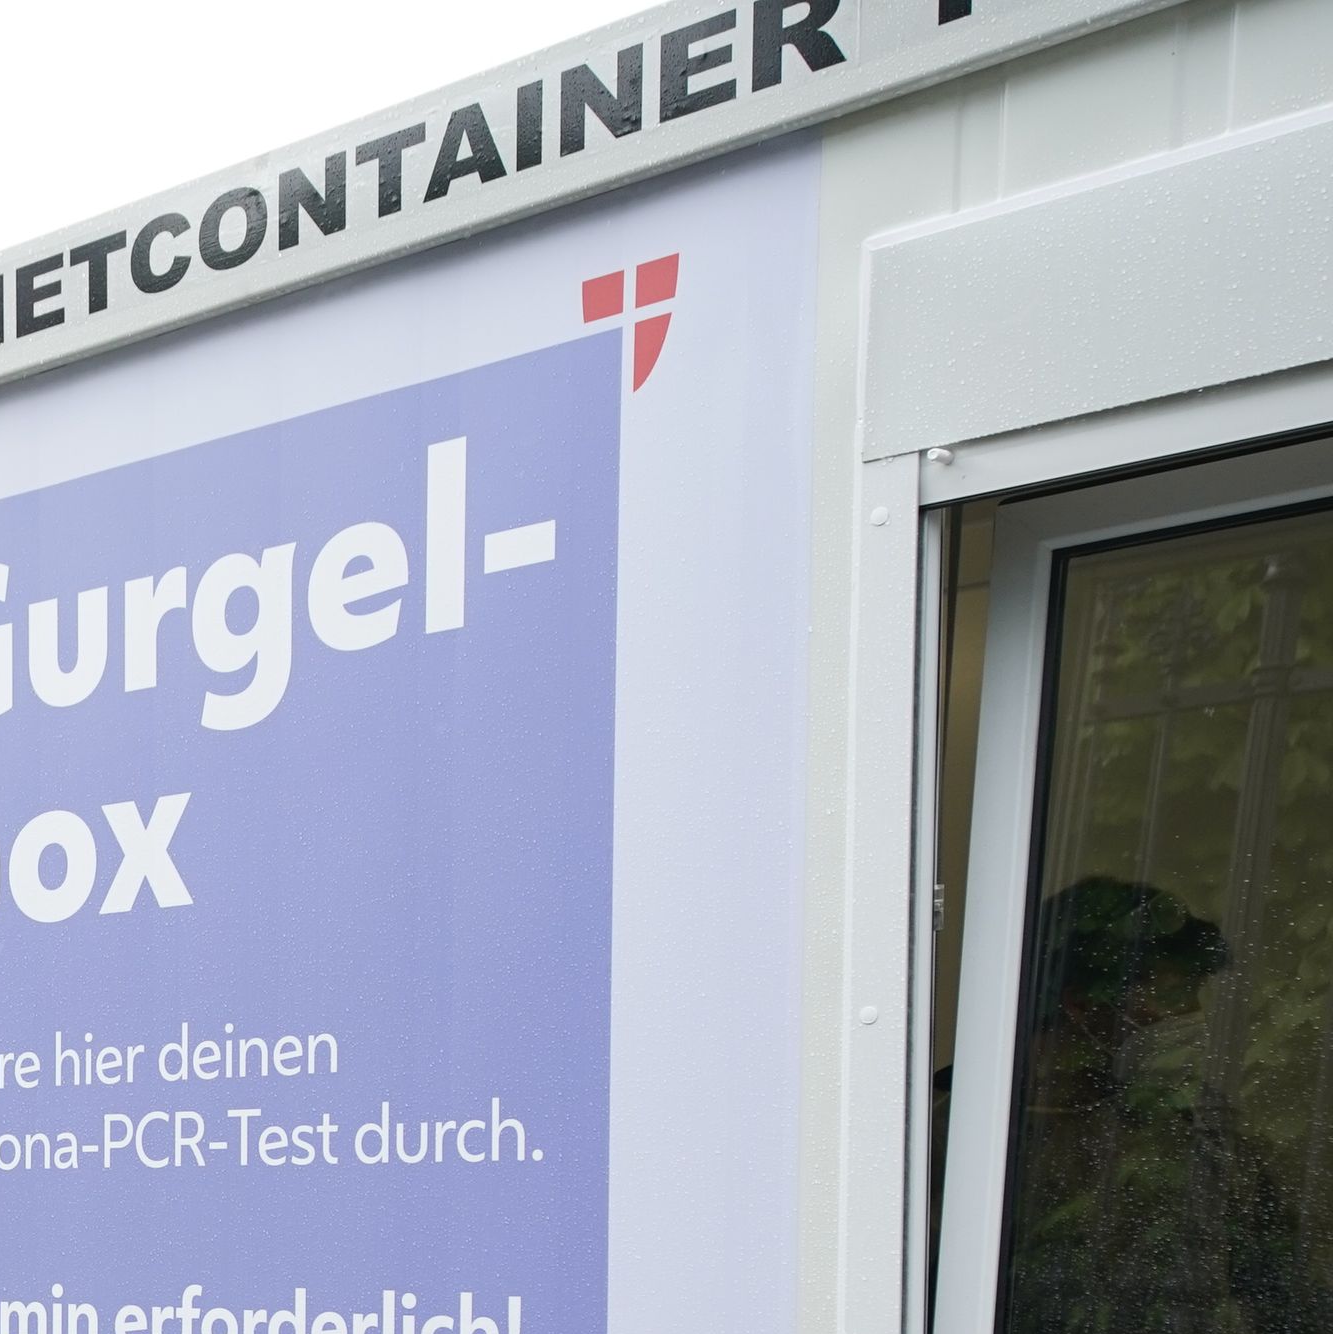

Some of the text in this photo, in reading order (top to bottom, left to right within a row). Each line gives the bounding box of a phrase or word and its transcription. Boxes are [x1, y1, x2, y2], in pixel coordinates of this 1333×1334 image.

[55, 1031, 145, 1087] hier
[158, 1021, 338, 1082] deinen
[354, 1097, 544, 1165] durch.
